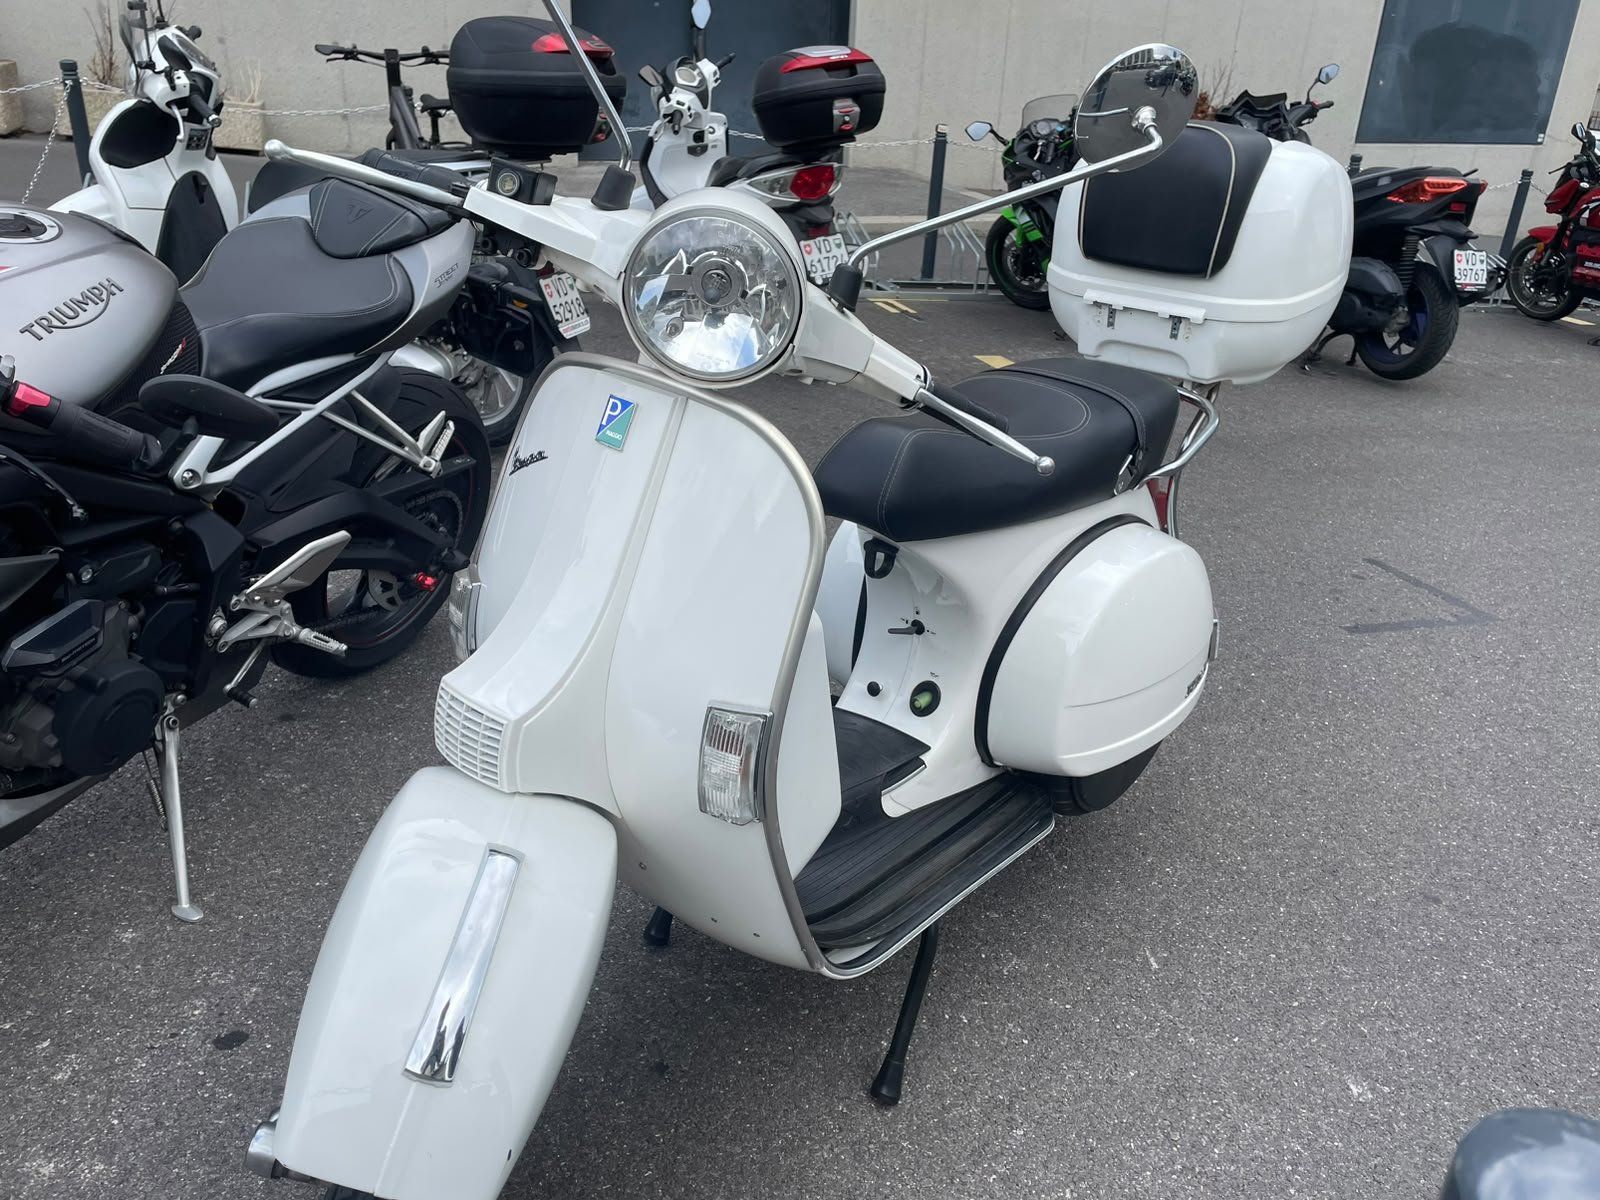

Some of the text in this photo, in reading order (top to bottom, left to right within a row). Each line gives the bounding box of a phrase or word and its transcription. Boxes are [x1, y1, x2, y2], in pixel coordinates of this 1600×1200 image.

[814, 238, 832, 255] VD
[1464, 252, 1477, 266] VD
[1456, 268, 1486, 281] 39767
[550, 277, 568, 298] VD
[19, 277, 124, 341] TRIUMPH
[552, 297, 585, 324] 52918
[601, 398, 622, 425] P
[509, 445, 549, 476] Vespa
